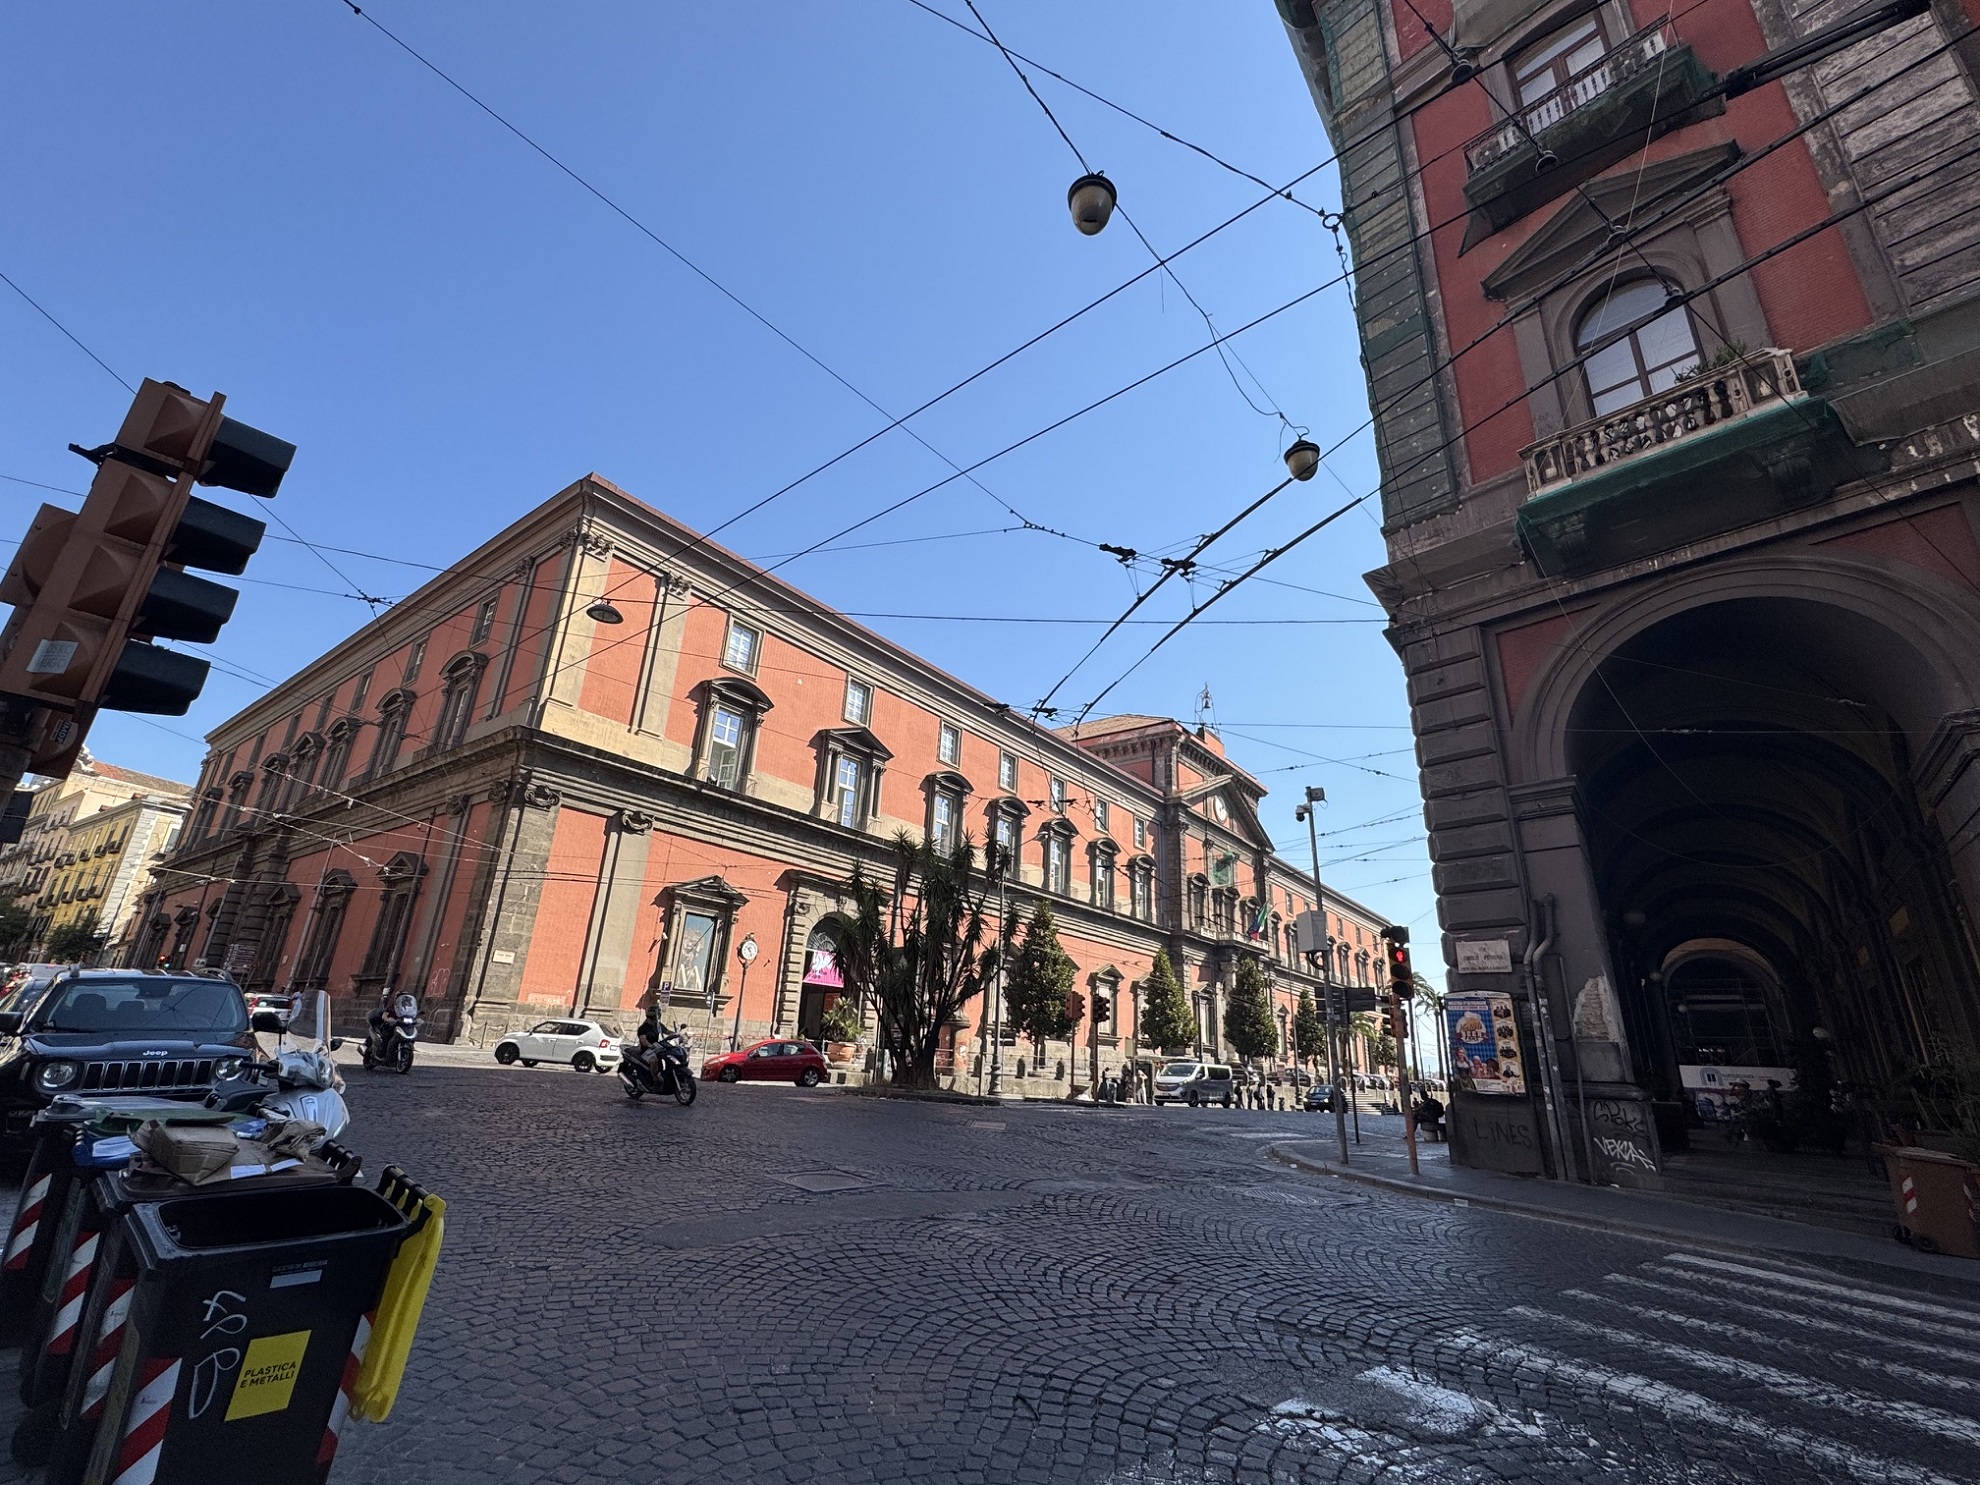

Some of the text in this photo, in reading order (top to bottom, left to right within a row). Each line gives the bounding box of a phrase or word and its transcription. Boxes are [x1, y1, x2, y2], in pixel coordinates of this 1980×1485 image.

[244, 1361, 296, 1378] PLASTICA
[240, 1371, 295, 1389] E METALLI
